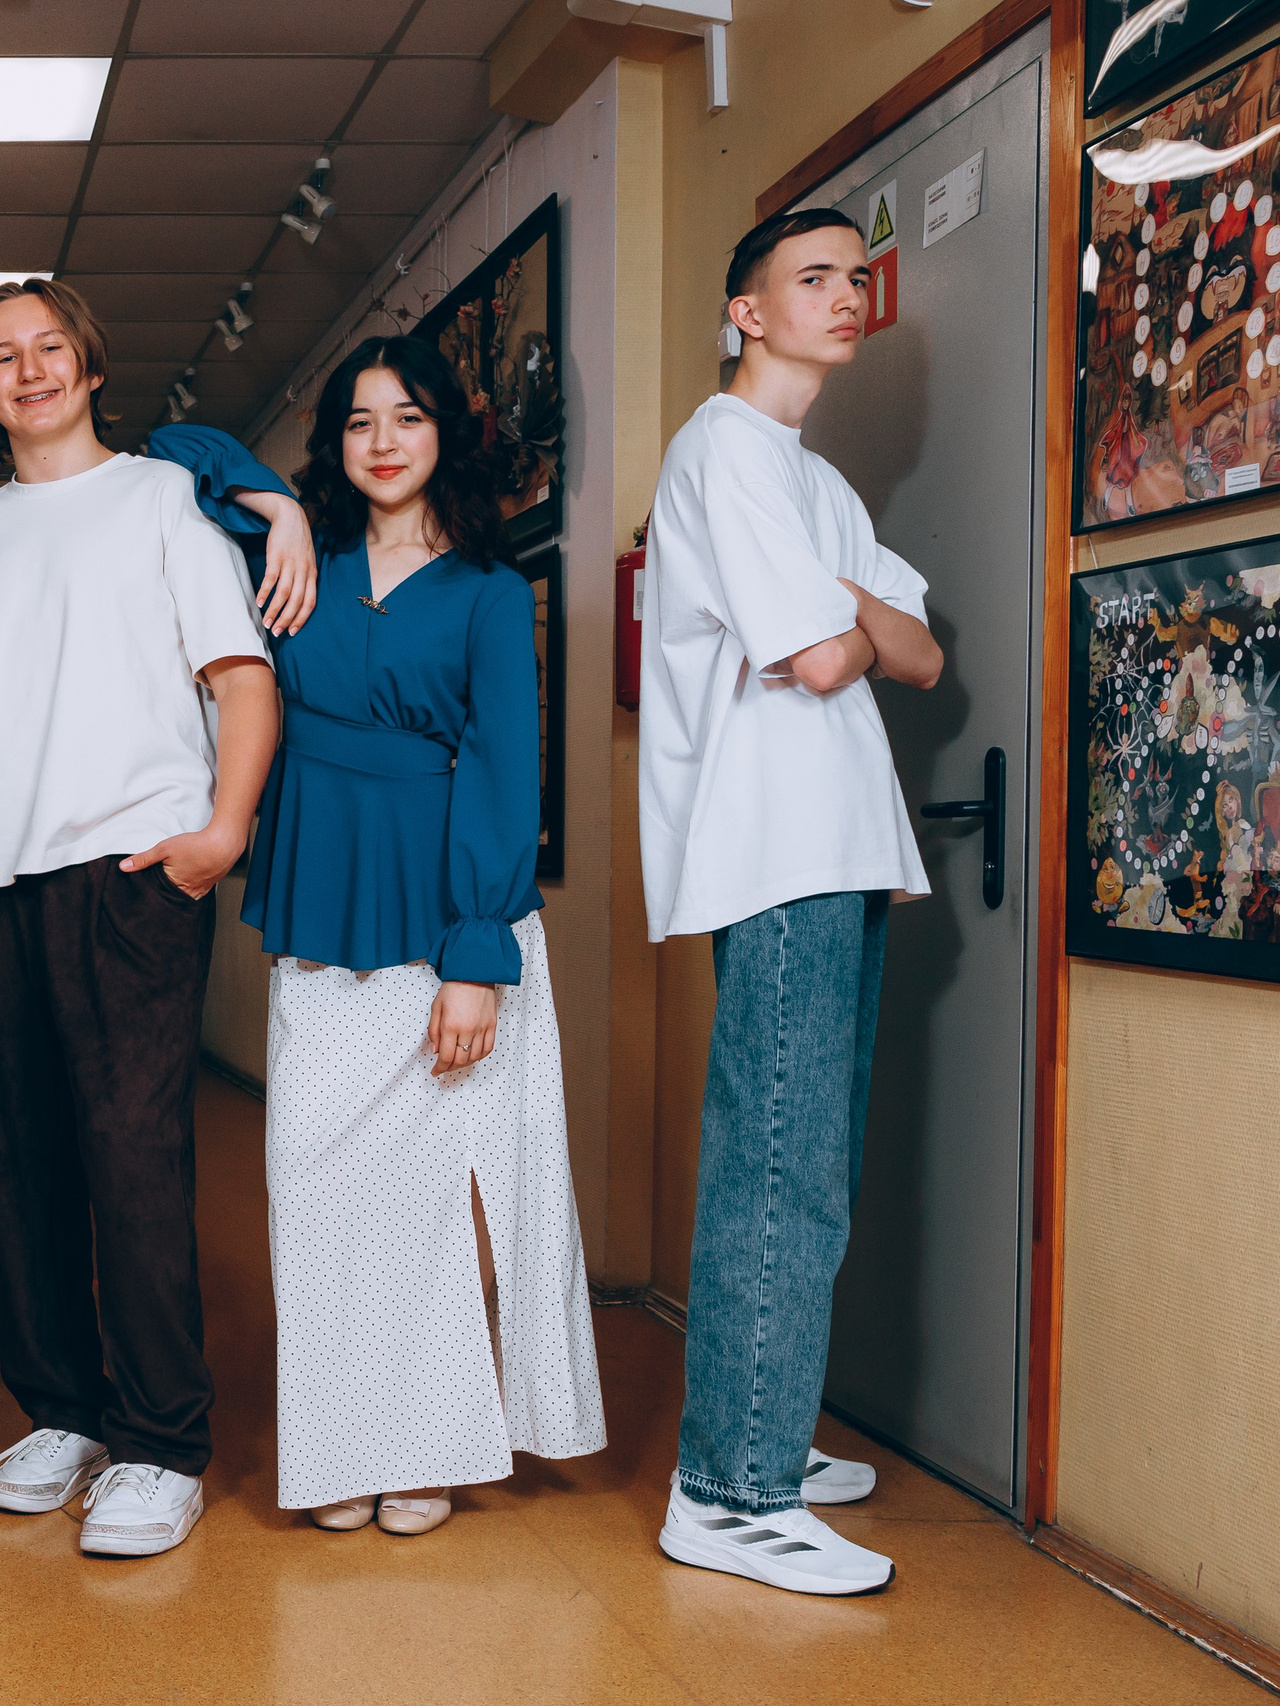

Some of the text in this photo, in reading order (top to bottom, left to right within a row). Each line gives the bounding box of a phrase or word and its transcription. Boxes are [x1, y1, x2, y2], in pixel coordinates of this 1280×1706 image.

[1138, 288, 1145, 305] 5
[1140, 321, 1146, 337] 6
[1175, 343, 1182, 359] 9
[1136, 356, 1144, 373] 7
[1155, 364, 1162, 381] 8
[1099, 593, 1155, 628] START
